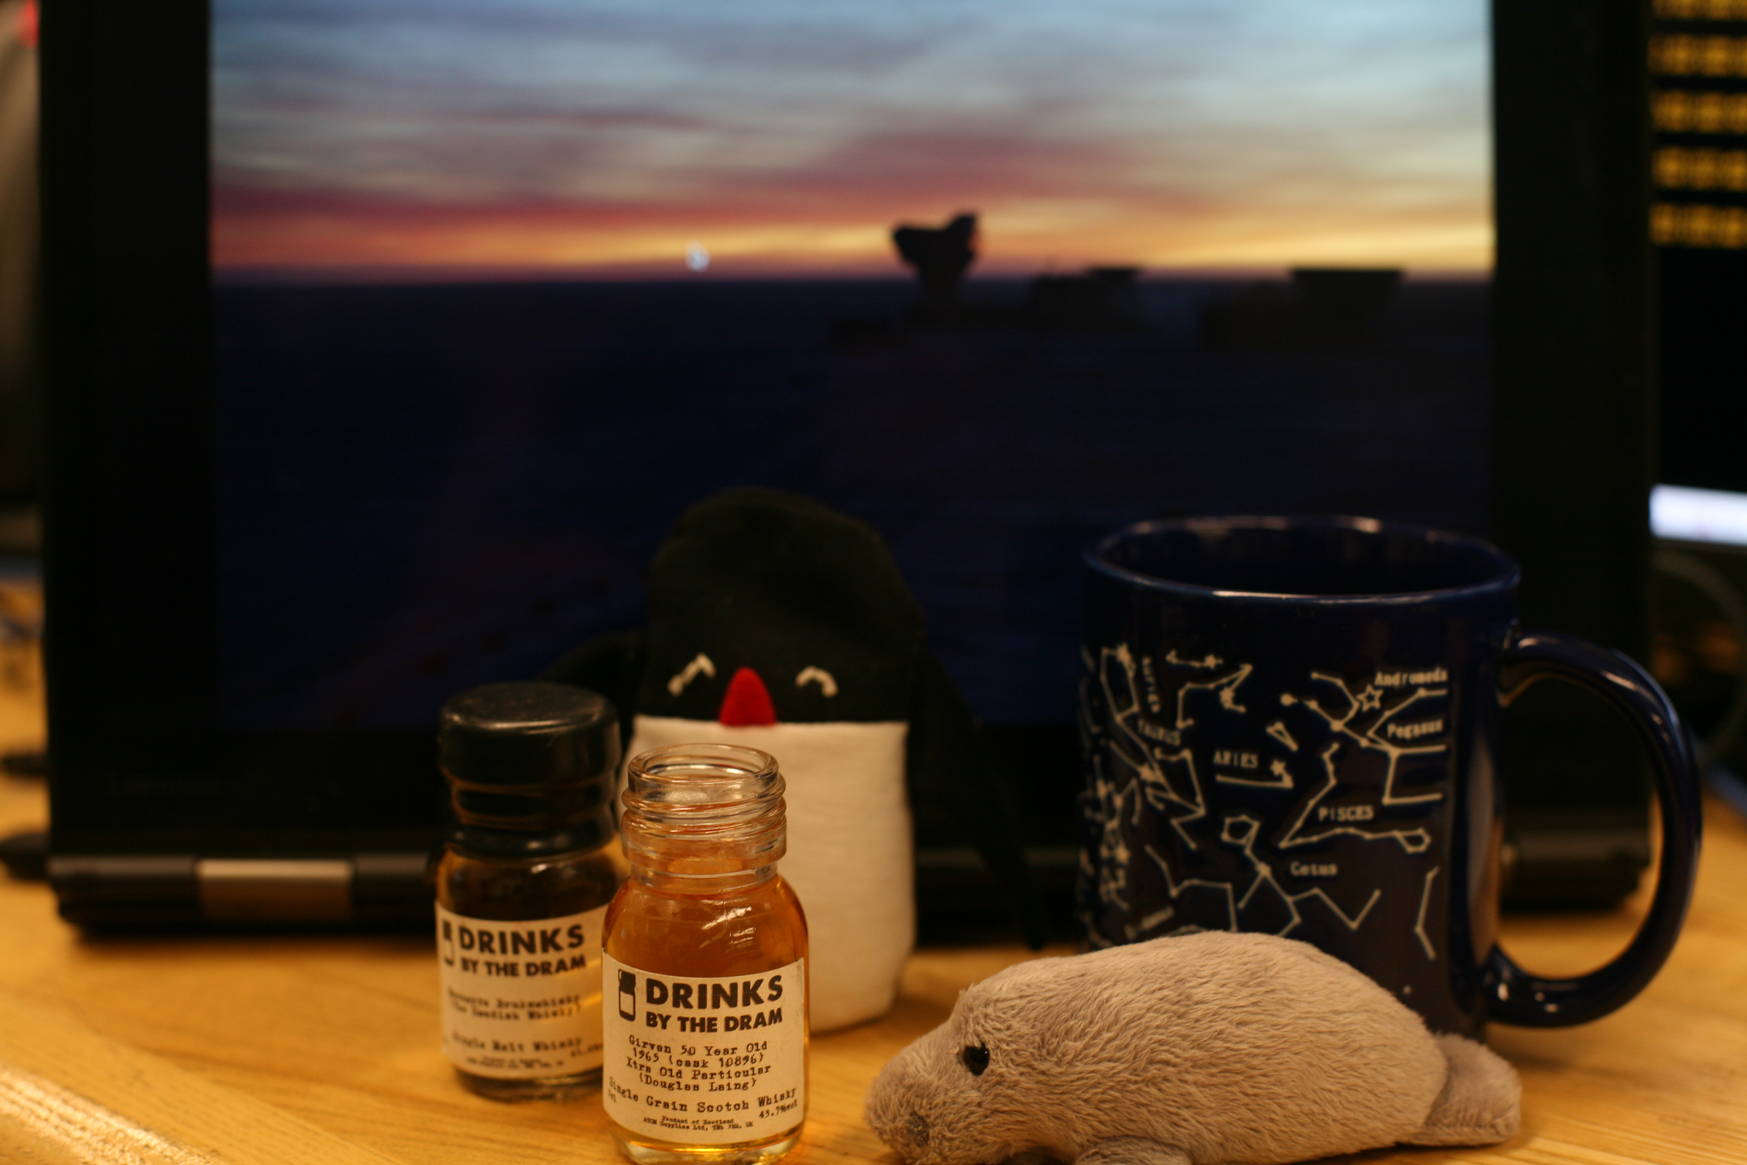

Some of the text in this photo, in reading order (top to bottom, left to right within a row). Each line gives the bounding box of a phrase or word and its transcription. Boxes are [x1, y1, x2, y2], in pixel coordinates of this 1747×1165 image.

[1213, 750, 1259, 769] ARIES
[1318, 804, 1374, 821] PISCES
[1290, 861, 1338, 876] Cetus
[459, 925, 585, 954] DRINKS
[461, 954, 586, 977] BY THE DRAM
[646, 975, 783, 1009] DRINKS
[646, 1008, 783, 1033] BY THE DRAM
[629, 1034, 768, 1057] Girvan 50 Year Old
[633, 1047, 764, 1069] 1965 (cask 10896)
[639, 1072, 757, 1092] (Douglas Laing)
[660, 1066, 683, 1079] Old
[691, 1065, 771, 1080] Particular
[646, 1095, 688, 1112] Grain
[697, 1100, 749, 1114] Scotch
